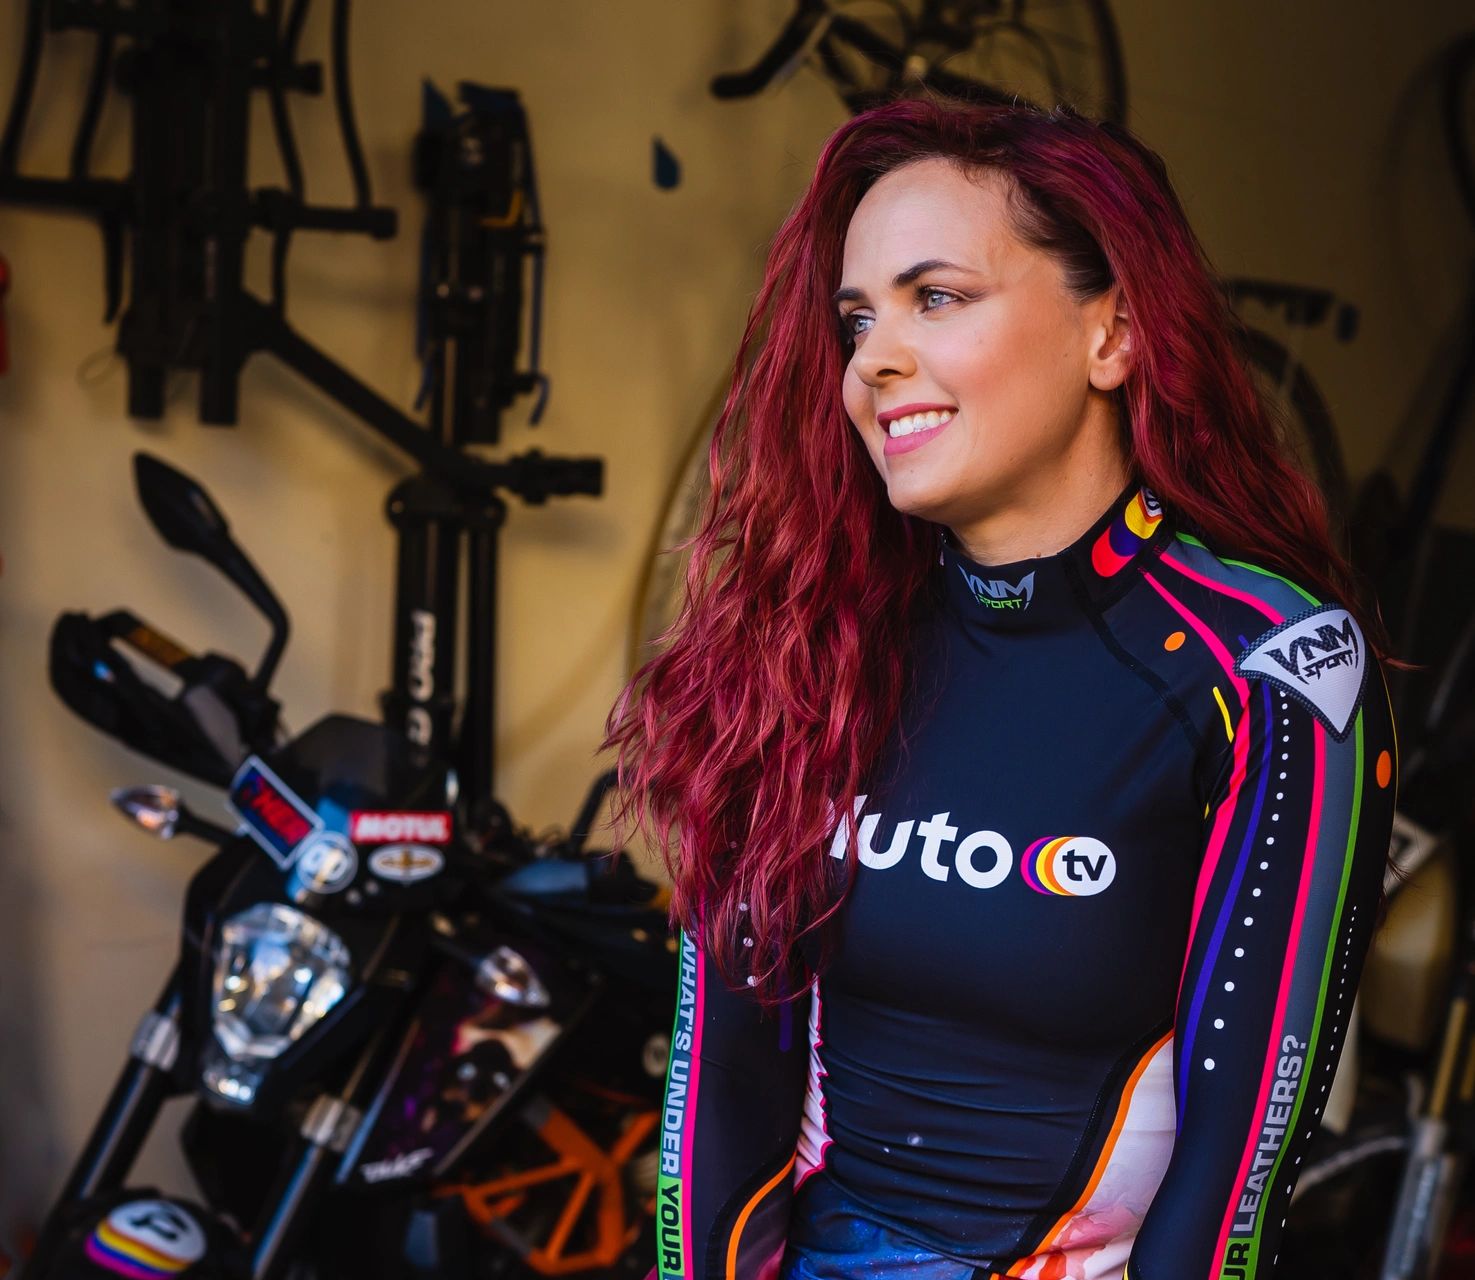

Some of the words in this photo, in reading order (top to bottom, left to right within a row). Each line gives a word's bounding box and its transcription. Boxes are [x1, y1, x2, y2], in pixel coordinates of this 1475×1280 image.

[957, 564, 1035, 603] VNM
[1263, 616, 1359, 677] VNM
[1301, 650, 1354, 680] SPORT
[826, 794, 1013, 889] luto
[1062, 848, 1108, 882] tv
[662, 1059, 689, 1175] UNDER
[1233, 1034, 1307, 1232] LEATHERS?
[660, 1184, 682, 1276] YOUR
